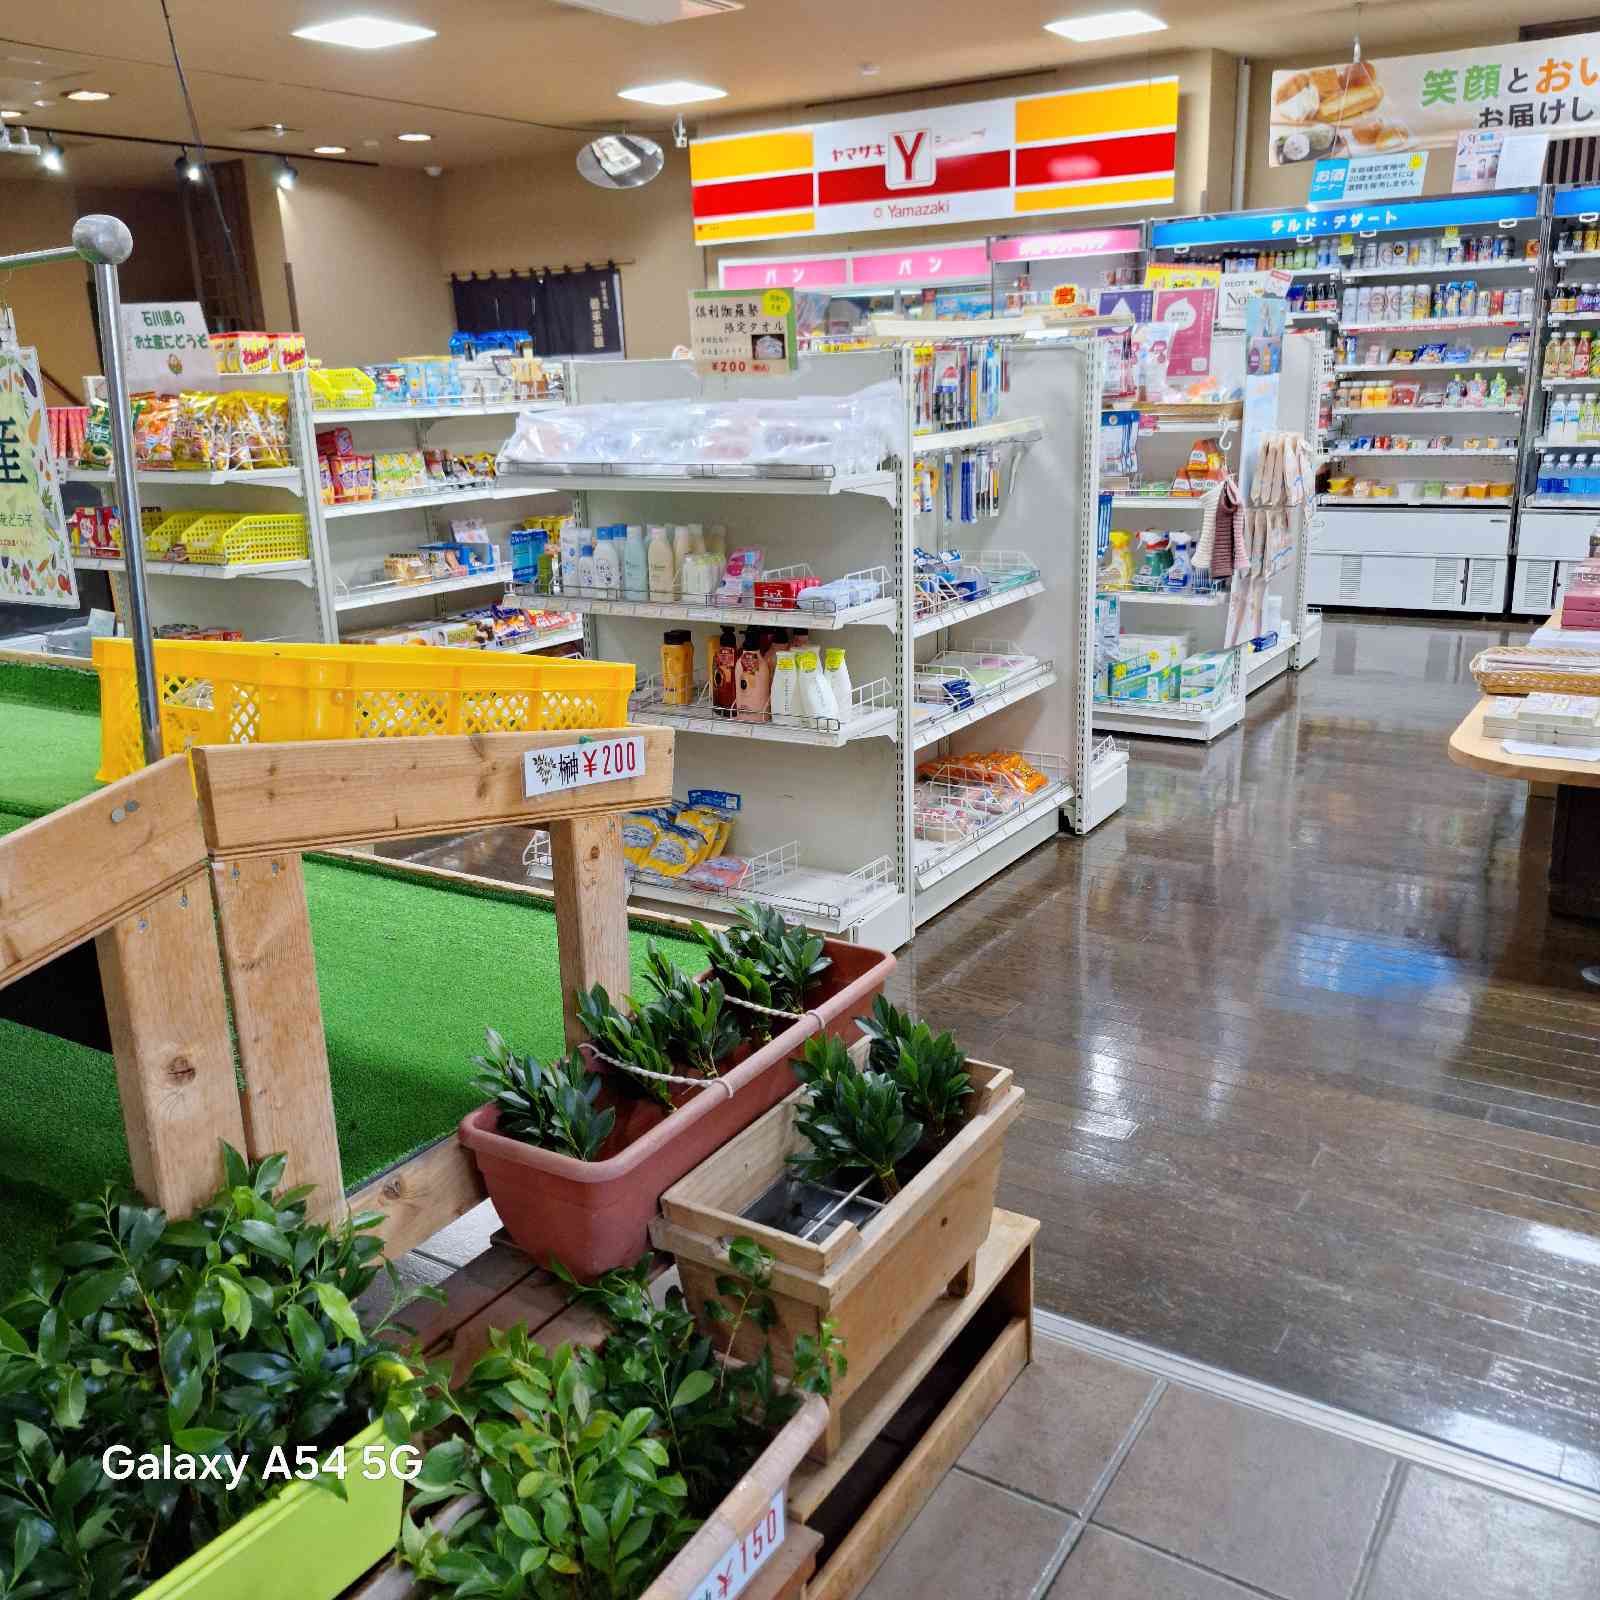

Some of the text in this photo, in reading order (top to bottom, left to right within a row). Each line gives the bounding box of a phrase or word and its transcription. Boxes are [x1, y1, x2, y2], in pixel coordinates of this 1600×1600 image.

[1478, 97, 1594, 129] お届けし
[893, 131, 925, 181] Y
[888, 200, 950, 219] Yamazaki
[1271, 208, 1398, 235] チルド・デザート
[582, 741, 636, 778] ¥200
